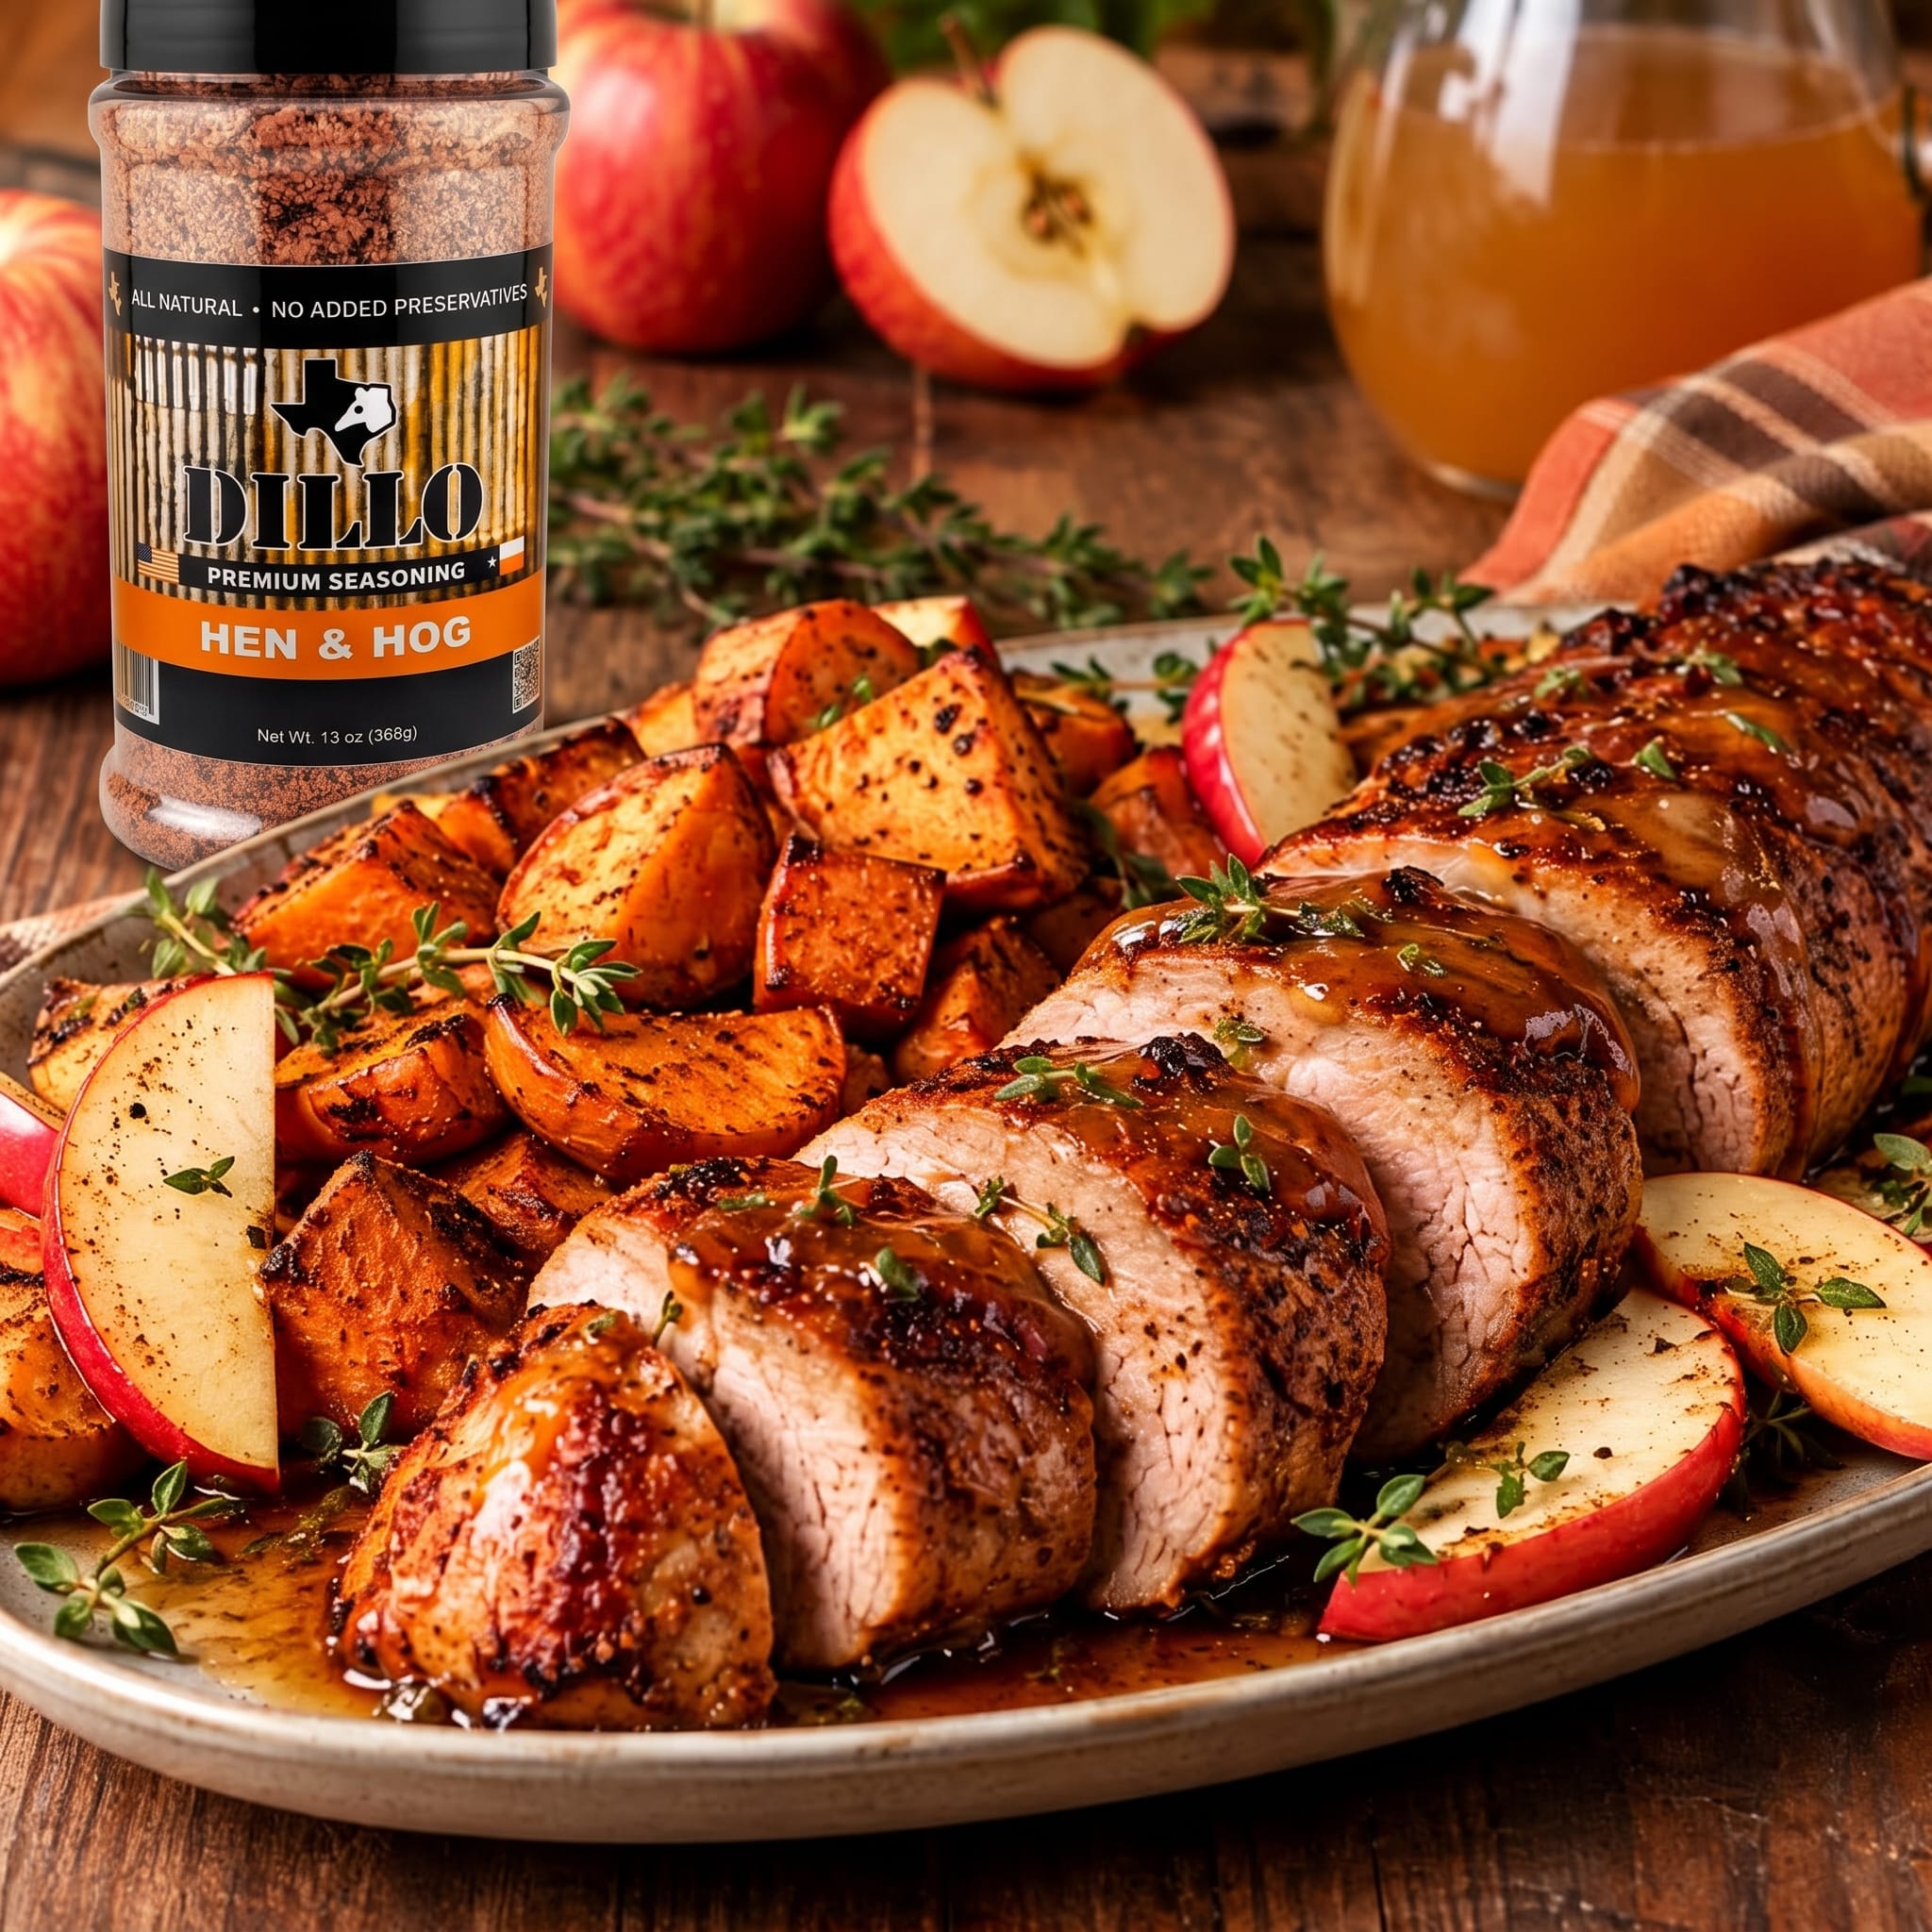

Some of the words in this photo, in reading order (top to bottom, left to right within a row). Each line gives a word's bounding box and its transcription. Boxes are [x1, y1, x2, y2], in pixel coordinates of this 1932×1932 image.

[131, 289, 156, 309] ALL
[158, 293, 243, 317] NATURAL
[272, 300, 304, 319] NO
[310, 300, 387, 319] ADDED
[394, 283, 528, 315] PRESERVATIVES
[182, 462, 484, 551] DILLO
[208, 566, 321, 591] PREMIUM
[329, 561, 465, 591] SEASONING
[200, 621, 297, 659] HEN
[318, 628, 354, 659] &
[373, 615, 472, 658] HOG
[258, 728, 285, 744] Net
[289, 729, 315, 745] Wt.
[321, 731, 340, 744] 13
[344, 733, 363, 744] oz
[368, 725, 418, 746] (368g)
